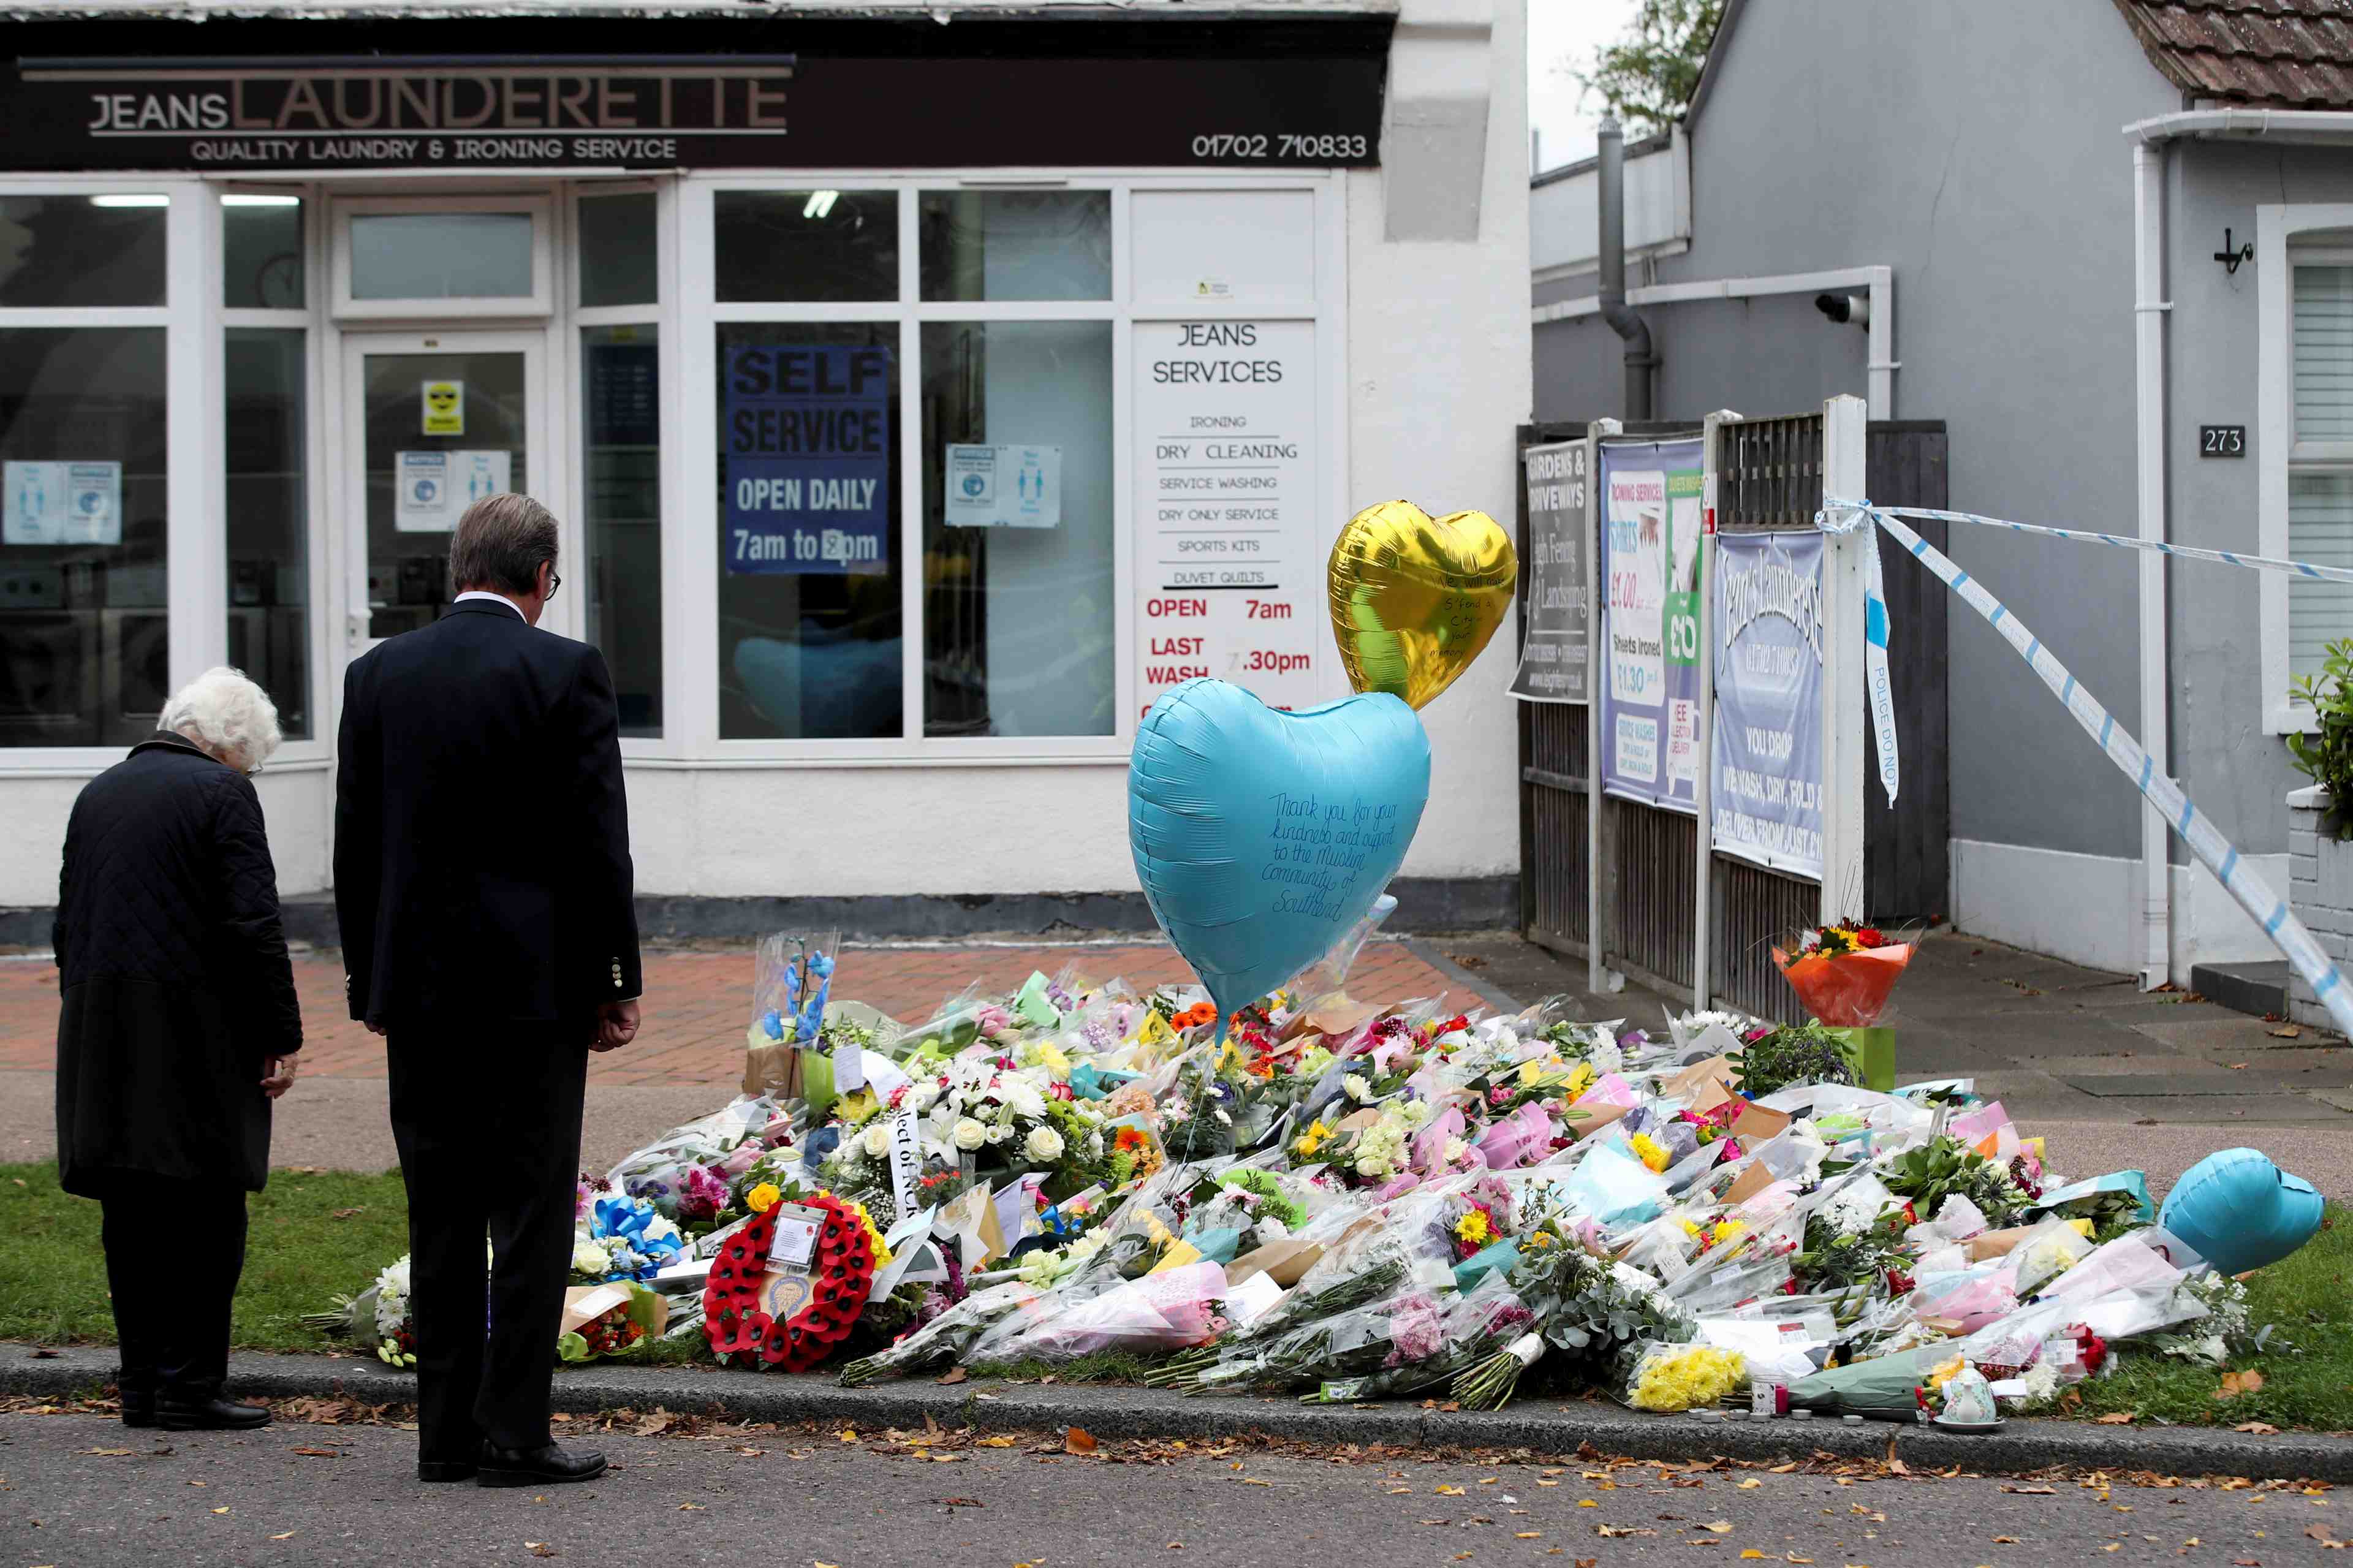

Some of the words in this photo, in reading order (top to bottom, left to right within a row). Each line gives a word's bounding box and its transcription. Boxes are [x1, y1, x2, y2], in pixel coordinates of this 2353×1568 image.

[89, 94, 229, 129] JEANS
[231, 76, 787, 128] LAUNDERETTE
[191, 140, 299, 160] QUALITY
[308, 140, 419, 159] LAUNDRY
[429, 140, 444, 158] &
[455, 139, 563, 158] IRONING
[573, 139, 676, 158] SERVICE
[1192, 135, 1267, 157] 01702
[1278, 135, 1366, 157] 710833
[1178, 324, 1256, 346] JEANS
[735, 350, 883, 395] SELF
[1153, 361, 1282, 382] SERVICES
[733, 409, 881, 452] SERVICE
[1191, 416, 1246, 428] IRONING
[1156, 445, 1190, 459] DRY
[1206, 444, 1297, 459] CLEANING
[2206, 430, 2240, 451] 273
[1575, 450, 1585, 475] &
[738, 478, 801, 510] OPEN
[809, 479, 876, 510] DAILY
[1159, 477, 1213, 490] SERVICE
[1219, 477, 1277, 489] WASHING
[1159, 510, 1183, 520] DRY
[1189, 509, 1220, 520] ONLY
[1226, 509, 1278, 520] SERVICE
[734, 529, 786, 559] 7am
[793, 529, 817, 559] to
[1178, 540, 1226, 551] SPORTS
[1232, 540, 1259, 551] KITS
[1174, 572, 1214, 583] DUVET
[1221, 572, 1264, 583] QUILTS
[1147, 599, 1207, 616] OPEN
[1246, 600, 1291, 618] 7am
[1151, 638, 1204, 655] LAST
[1147, 666, 1208, 683] WASH
[1875, 667, 1889, 724] POLICE
[1746, 727, 1765, 753] YOU
[1768, 730, 1793, 760] DROP
[1882, 729, 1892, 752] DO
[1883, 757, 1896, 788] NOT
[1723, 766, 1737, 792] WE
[1789, 779, 1814, 809] FOLD
[1270, 793, 1317, 819] Thank
[1325, 805, 1346, 827] you
[1354, 798, 1371, 827] for
[1374, 805, 1397, 831] your
[1336, 828, 1360, 846] and
[1718, 808, 1754, 841] DELIVER
[1756, 819, 1783, 848] FROM
[1784, 825, 1808, 855] JUST
[1275, 843, 1287, 860] to
[1293, 843, 1311, 863] the
[1262, 863, 1336, 892] Community
[1342, 871, 1357, 897] of
[1273, 890, 1344, 922] Southend
[897, 1107, 912, 1144] lect
[900, 1150, 918, 1169] of
